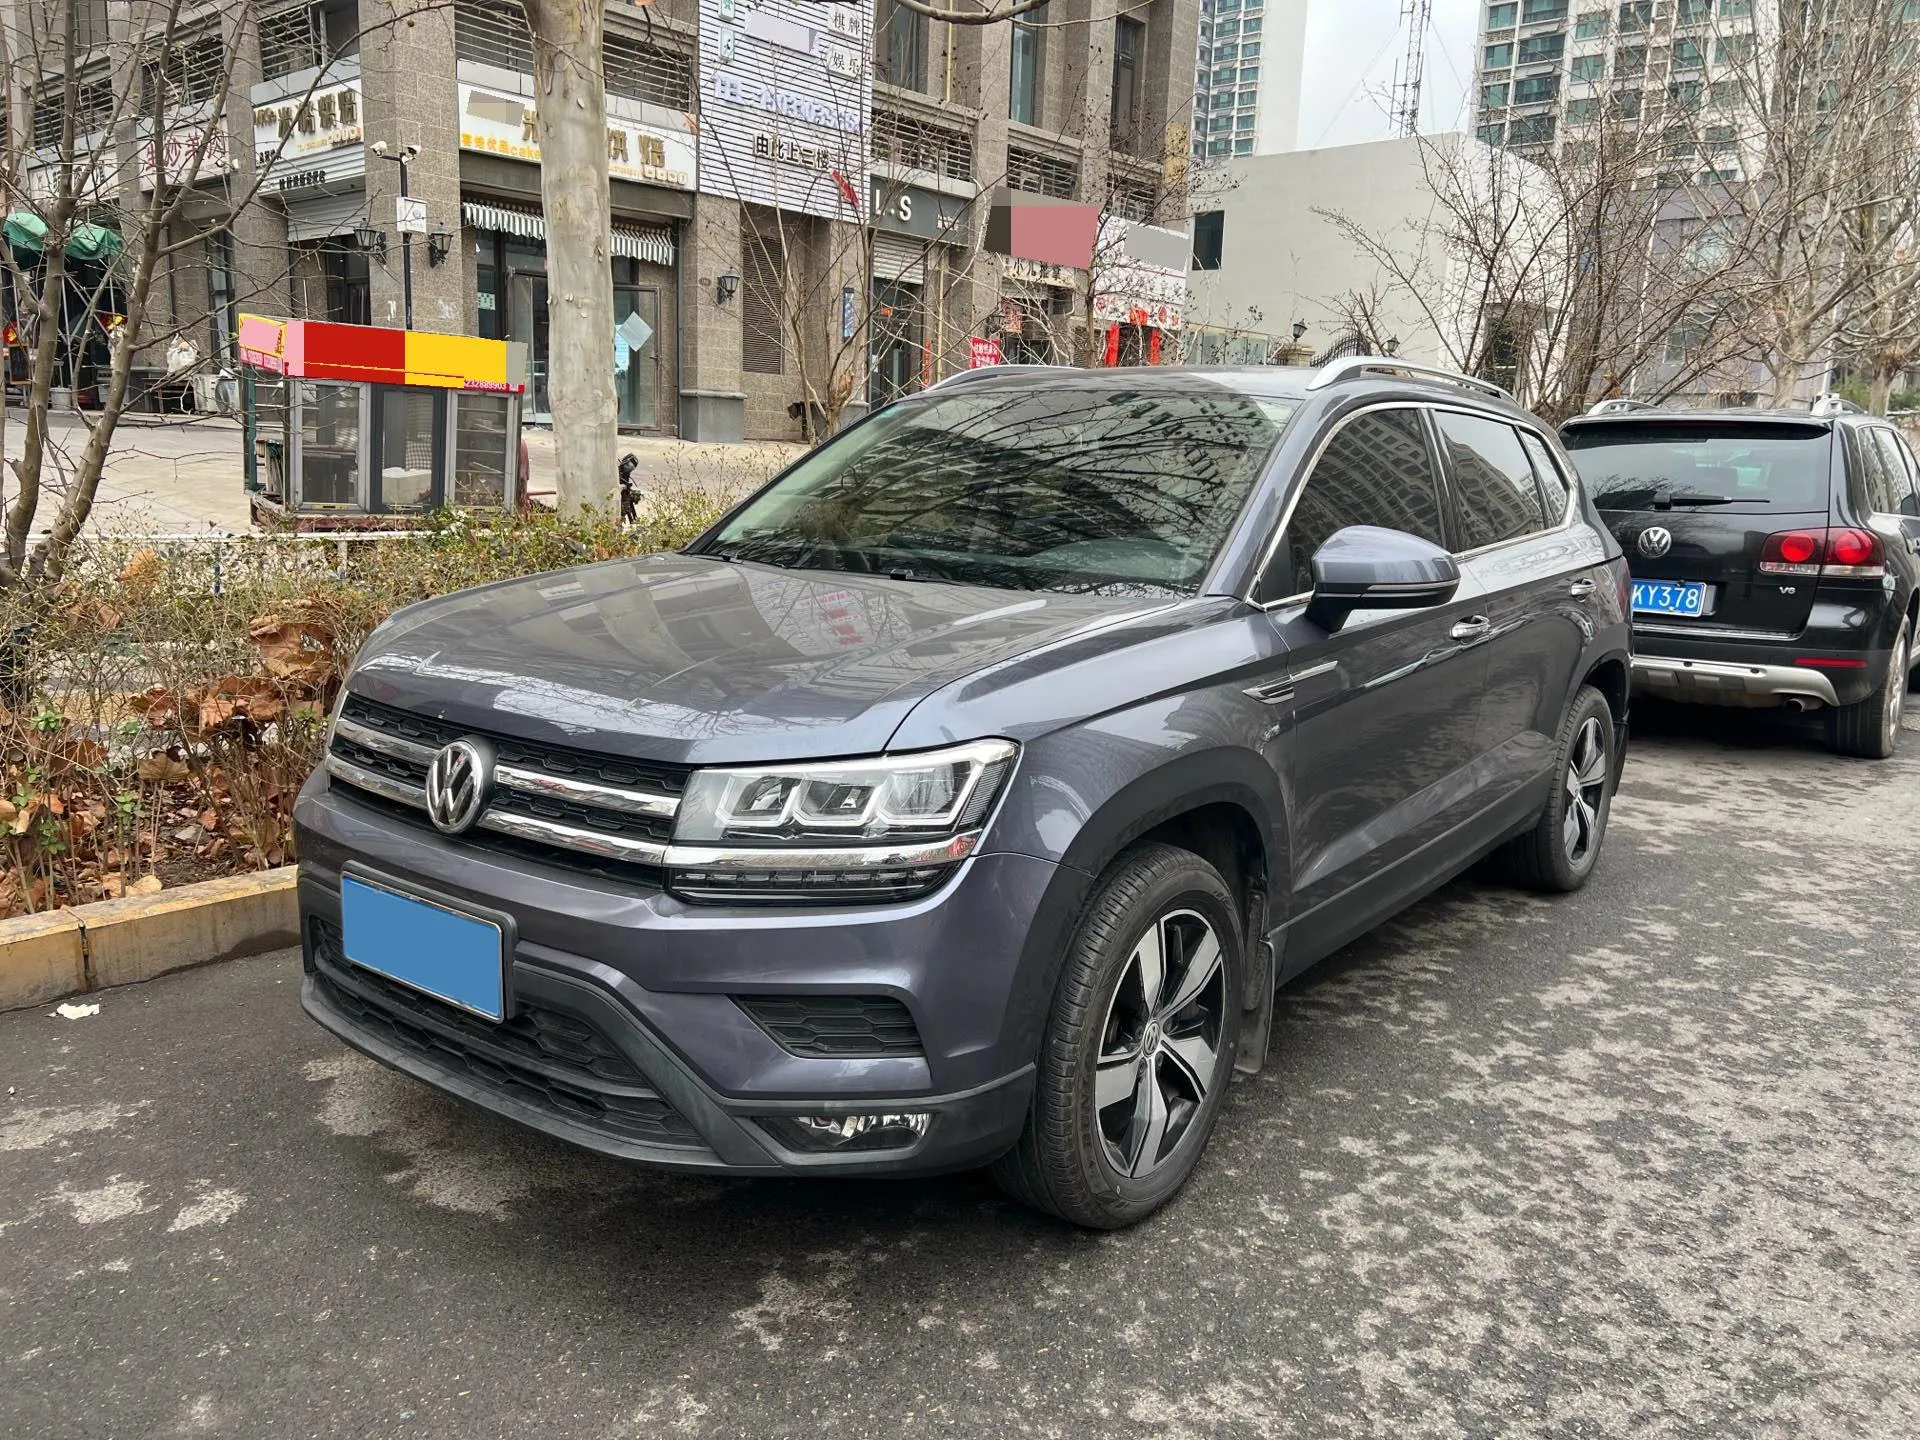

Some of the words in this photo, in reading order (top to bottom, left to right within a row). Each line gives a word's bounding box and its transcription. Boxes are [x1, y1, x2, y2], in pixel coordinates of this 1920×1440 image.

[833, 12, 861, 36] 棋牌
[832, 52, 862, 76] 娱乐
[1632, 584, 1699, 609] KY378
[1779, 586, 1796, 595] V6
[427, 742, 482, 833] VW
